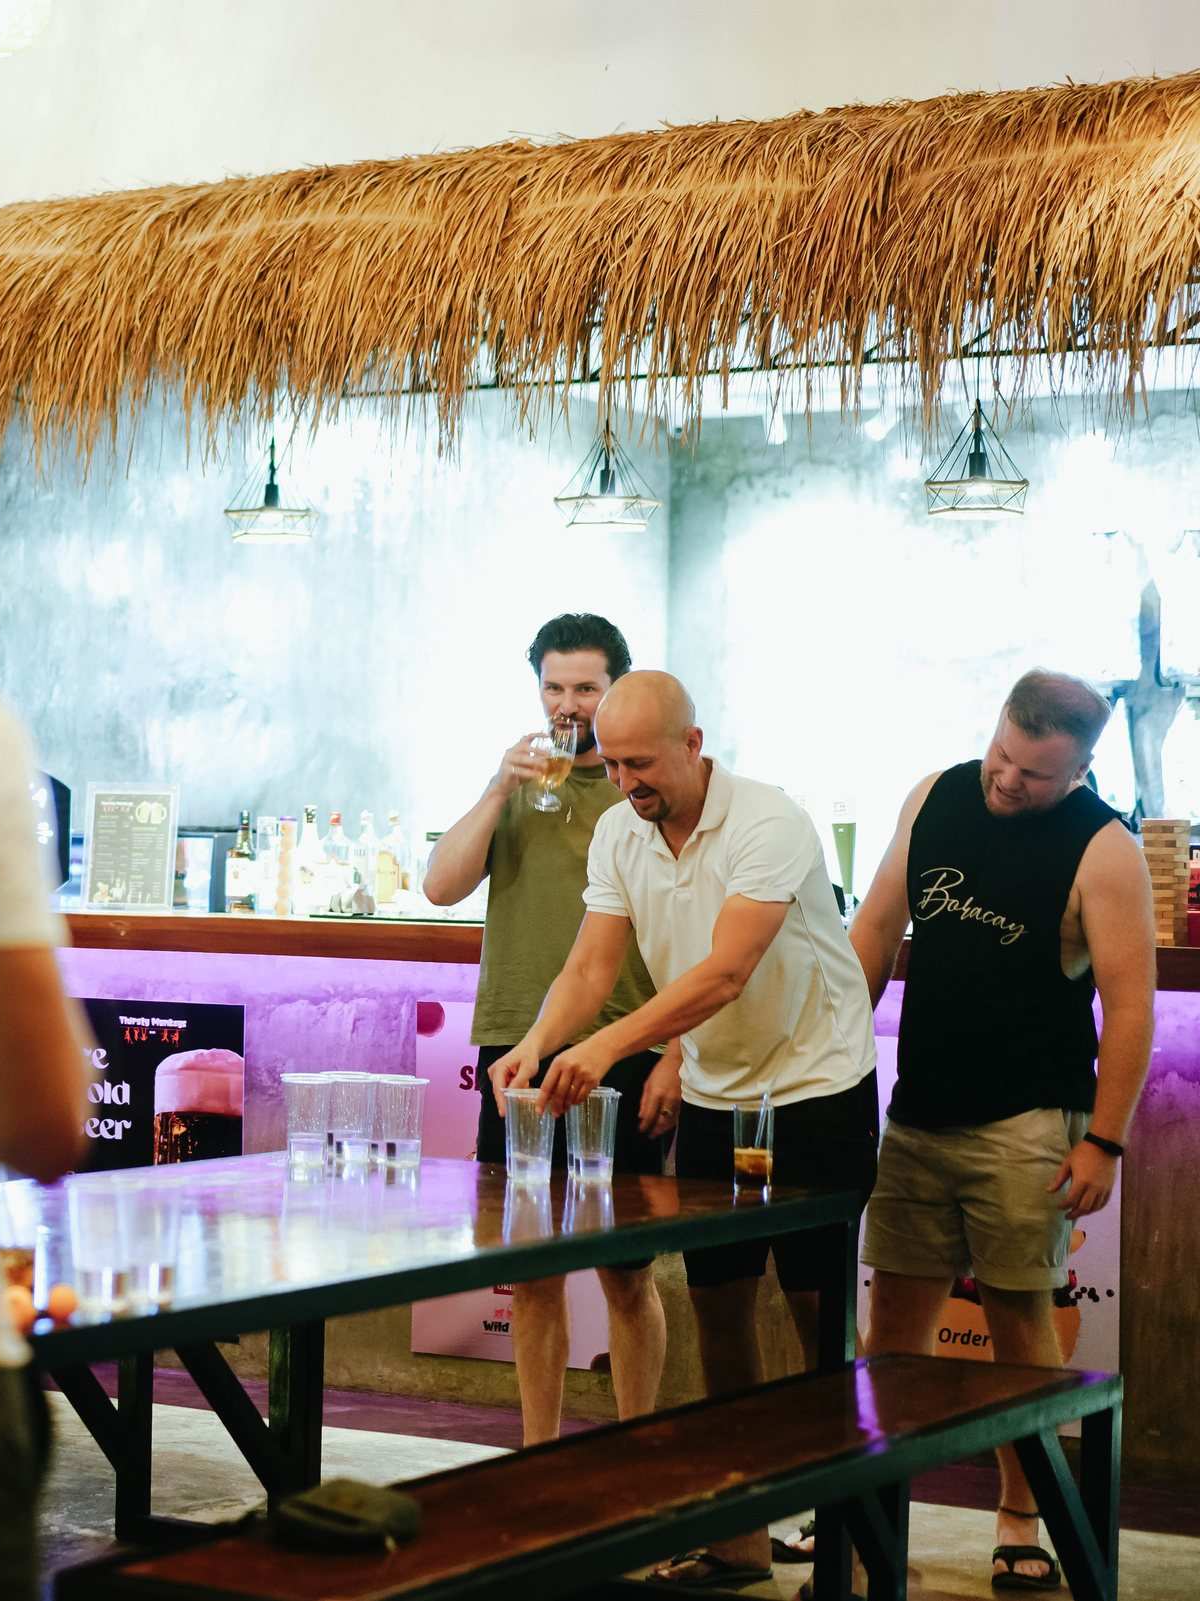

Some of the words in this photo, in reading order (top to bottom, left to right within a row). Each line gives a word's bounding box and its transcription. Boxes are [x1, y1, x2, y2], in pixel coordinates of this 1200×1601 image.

[915, 867, 1029, 945] Boracay
[81, 1117, 132, 1140] eer
[482, 1320, 510, 1333] Wild
[938, 1327, 992, 1347] Order
